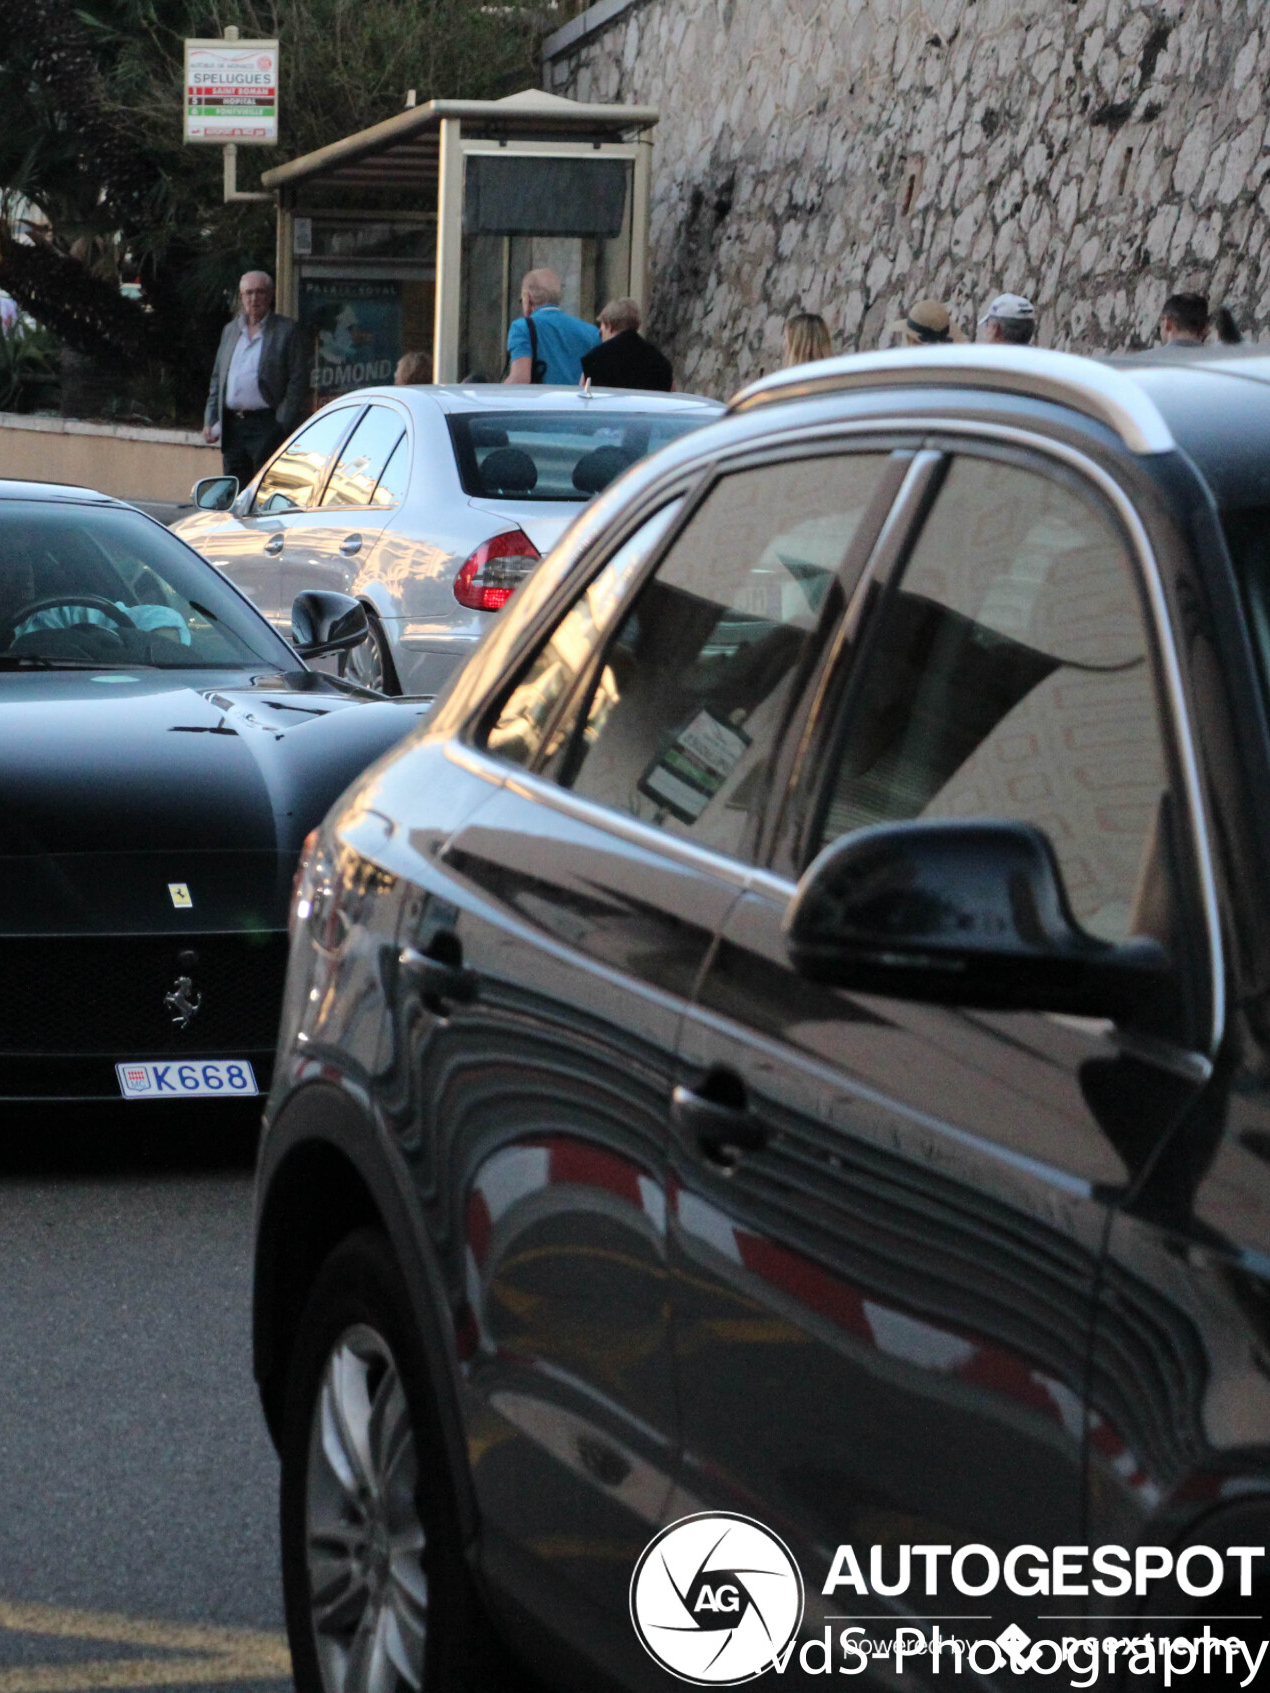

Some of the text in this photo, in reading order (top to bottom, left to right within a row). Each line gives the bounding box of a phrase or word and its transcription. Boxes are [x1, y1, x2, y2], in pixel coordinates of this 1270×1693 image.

[193, 73, 272, 85] SPELUGUES
[212, 87, 236, 95] SAINT
[238, 87, 269, 95] ROMAN
[310, 359, 392, 388] EDMOND
[152, 1064, 248, 1091] K668
